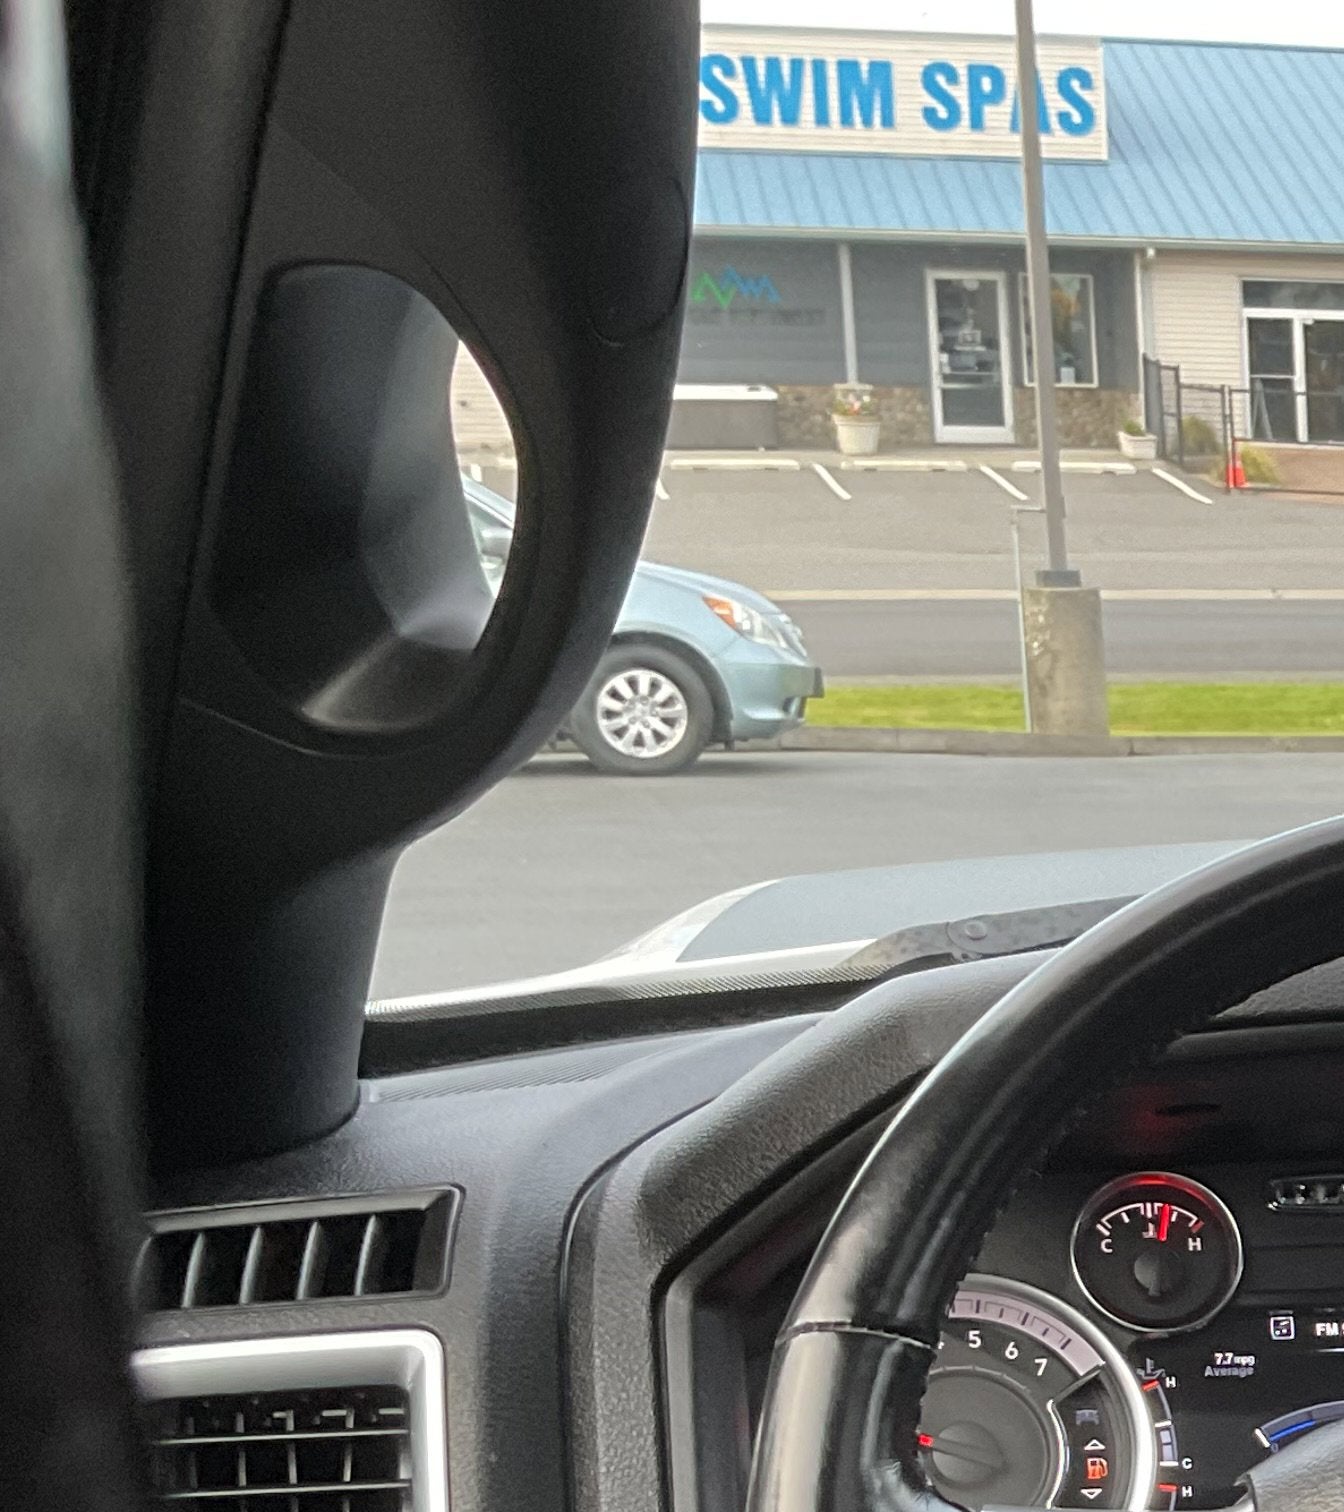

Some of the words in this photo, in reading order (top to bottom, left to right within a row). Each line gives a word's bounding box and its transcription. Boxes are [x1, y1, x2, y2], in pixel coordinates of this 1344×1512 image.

[699, 53, 896, 129] SWIM
[1100, 1238, 1113, 1253] C
[1188, 1237, 1202, 1252] H
[1315, 1322, 1339, 1336] FM
[968, 1330, 981, 1349] 5
[1005, 1341, 1019, 1360] 6
[1214, 1353, 1233, 1365] 7.7
[1034, 1358, 1048, 1377] 7
[1204, 1366, 1254, 1378] Average
[1165, 1376, 1176, 1388] H
[1182, 1458, 1192, 1469] C
